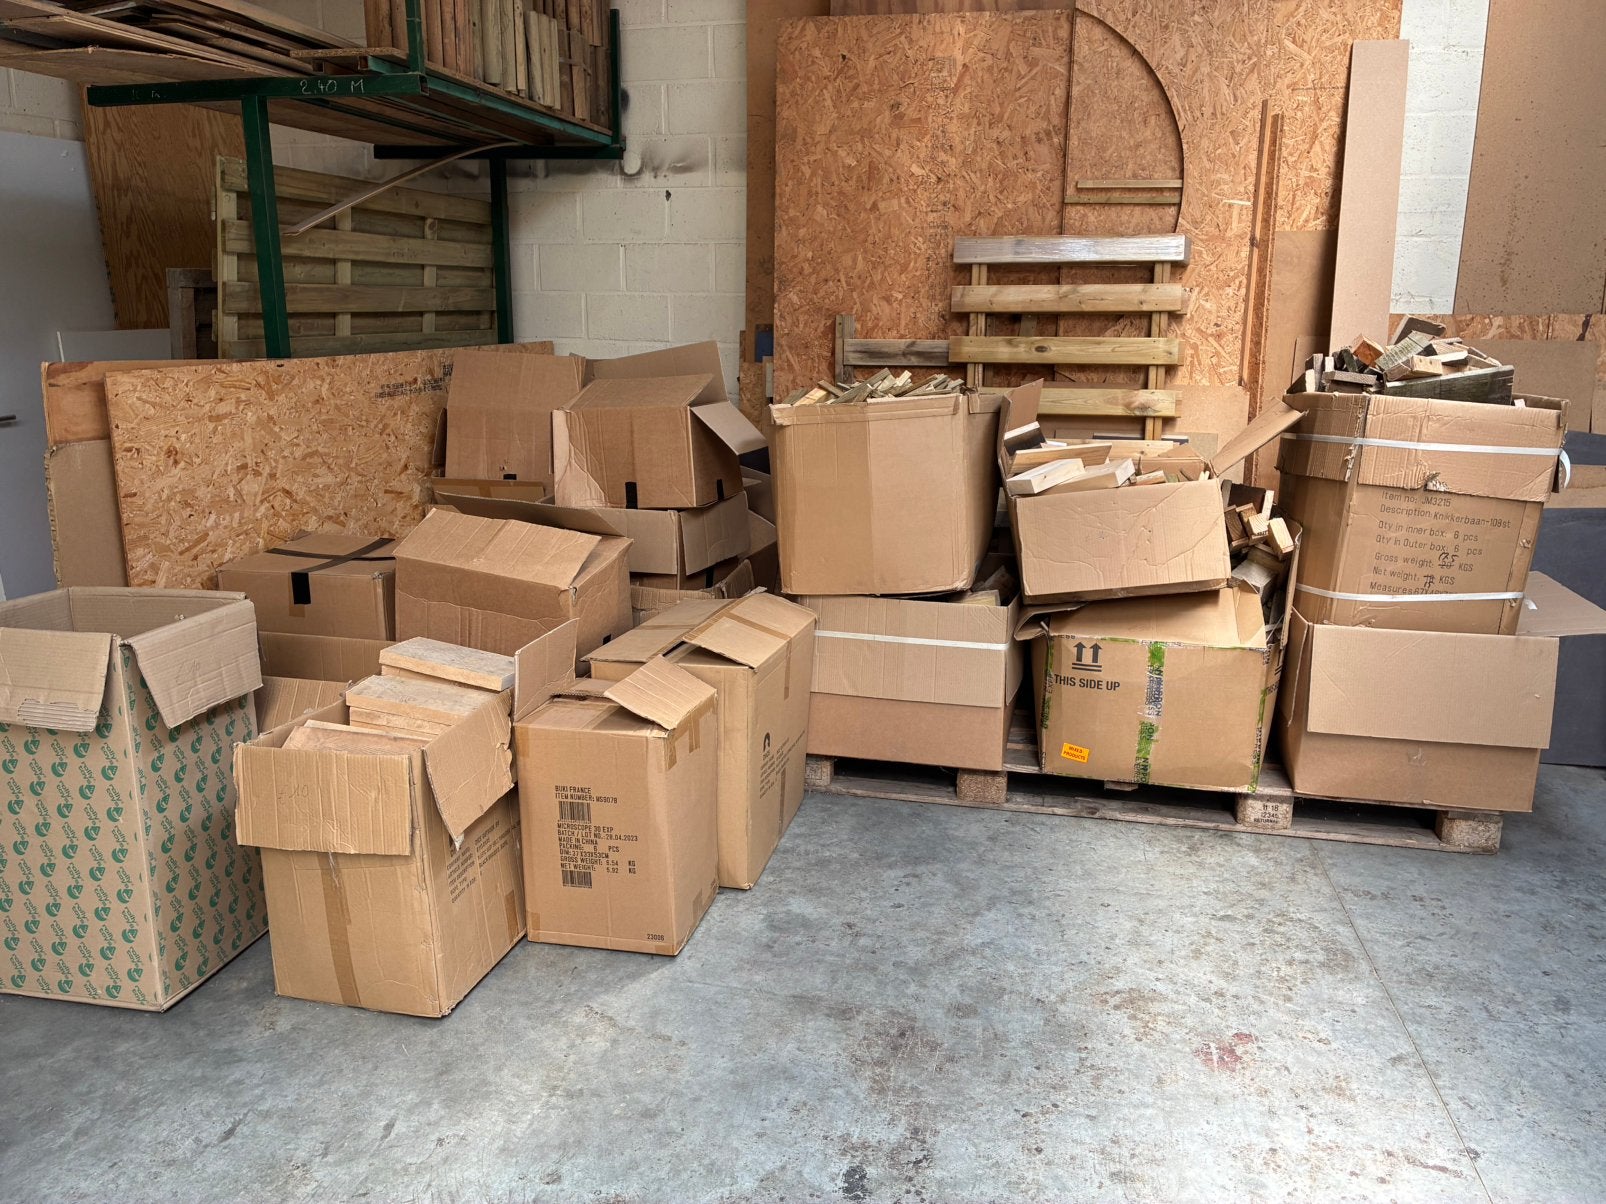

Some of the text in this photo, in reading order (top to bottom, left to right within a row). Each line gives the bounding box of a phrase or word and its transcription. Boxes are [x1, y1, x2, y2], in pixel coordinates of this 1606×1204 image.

[351, 78, 364, 93] M
[1382, 491, 1400, 501] Item
[1396, 523, 1402, 532] in
[1406, 524, 1427, 535] inner
[1463, 533, 1478, 542] pcs
[1394, 537, 1400, 546] in
[1403, 538, 1427, 549] Outer
[1466, 547, 1483, 556] pcs
[1375, 552, 1398, 563] Gross
[1458, 563, 1473, 572] KGS
[1373, 566, 1387, 576] Net
[1439, 576, 1455, 585] KGS
[1054, 673, 1076, 687] THIS
[1079, 678, 1103, 691] SIDE
[1106, 681, 1121, 692] UP
[570, 786, 591, 795] FRANCE
[570, 794, 595, 802] NUMBER:
[557, 822, 592, 832] MICROSCOPE
[558, 836, 573, 844] MADE
[582, 838, 598, 846] CHINA
[559, 842, 584, 851] PACKING:
[608, 845, 620, 853] PCS
[560, 855, 578, 864] GROSS
[580, 858, 603, 866] WEIGHT:
[560, 862, 571, 870] NET
[573, 864, 596, 872] WEIGHT:
